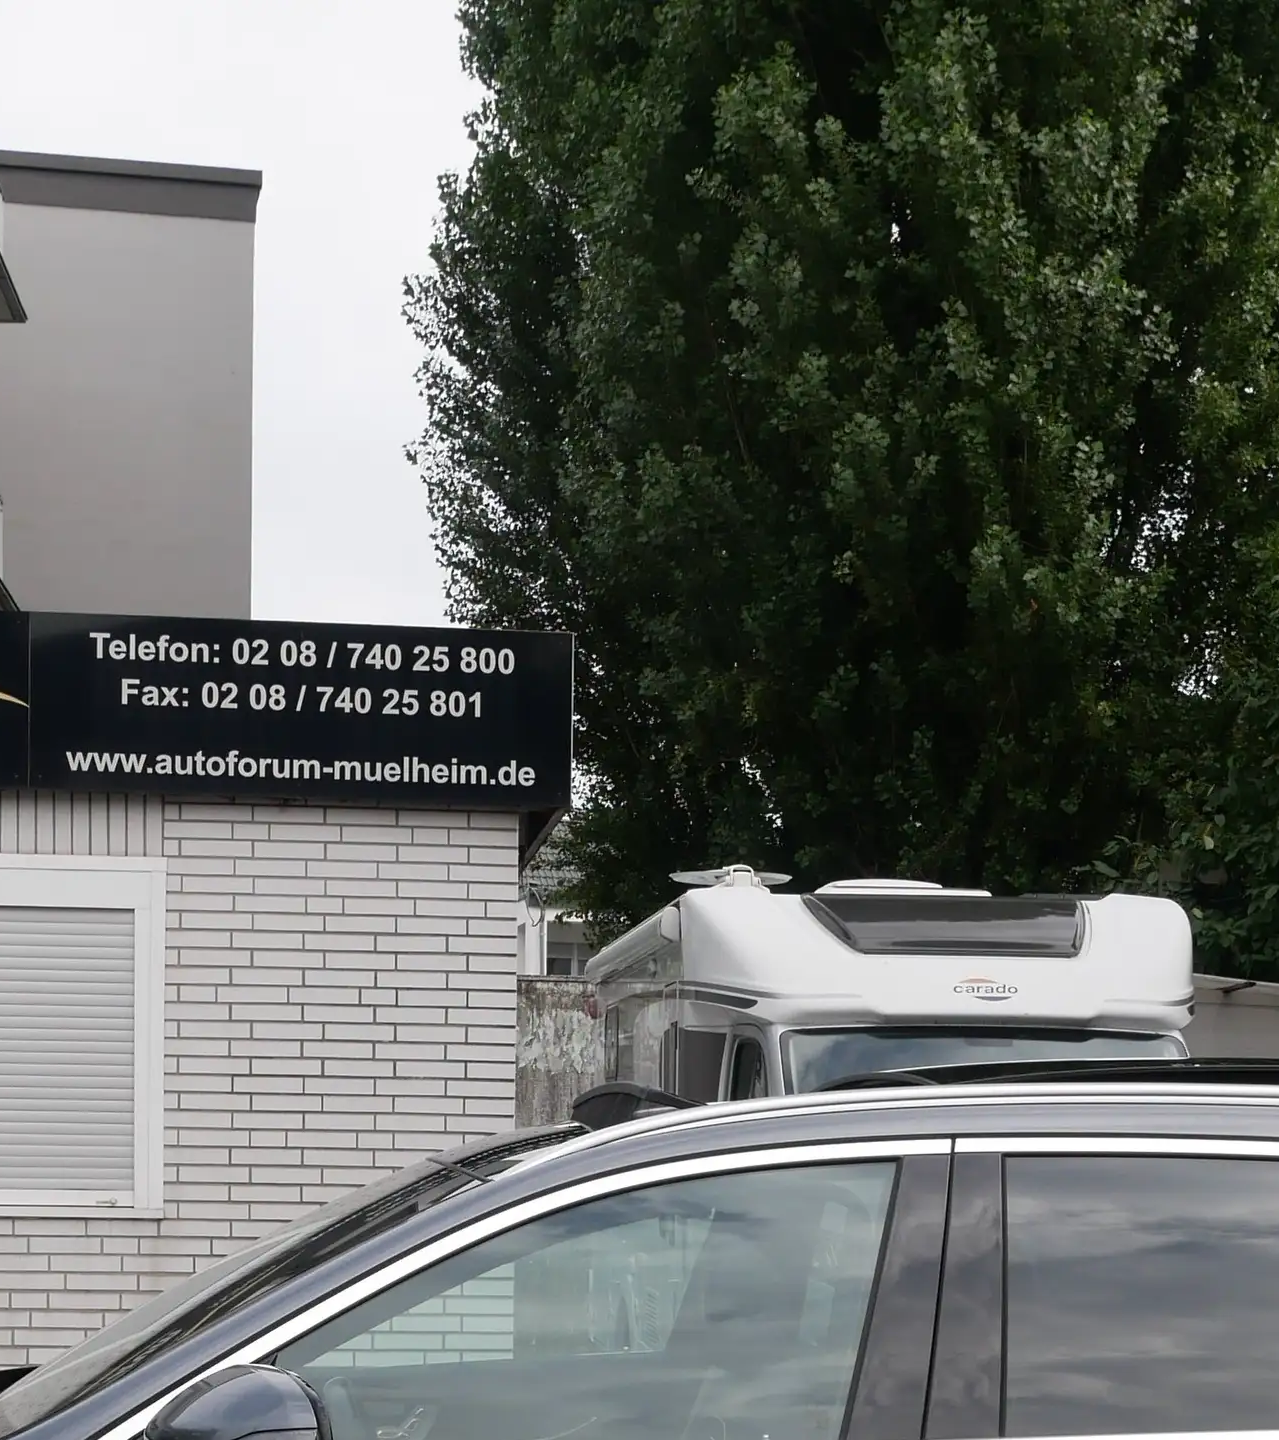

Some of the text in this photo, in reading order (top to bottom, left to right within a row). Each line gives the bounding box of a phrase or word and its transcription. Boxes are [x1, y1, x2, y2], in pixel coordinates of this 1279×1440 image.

[89, 632, 515, 675] Telefon: 02 08 / 740 25 800
[121, 678, 481, 718] Fax: 02 08 / 740 25 801
[65, 750, 537, 787] www.autoforum-muelheim.de
[953, 984, 1019, 994] carado
